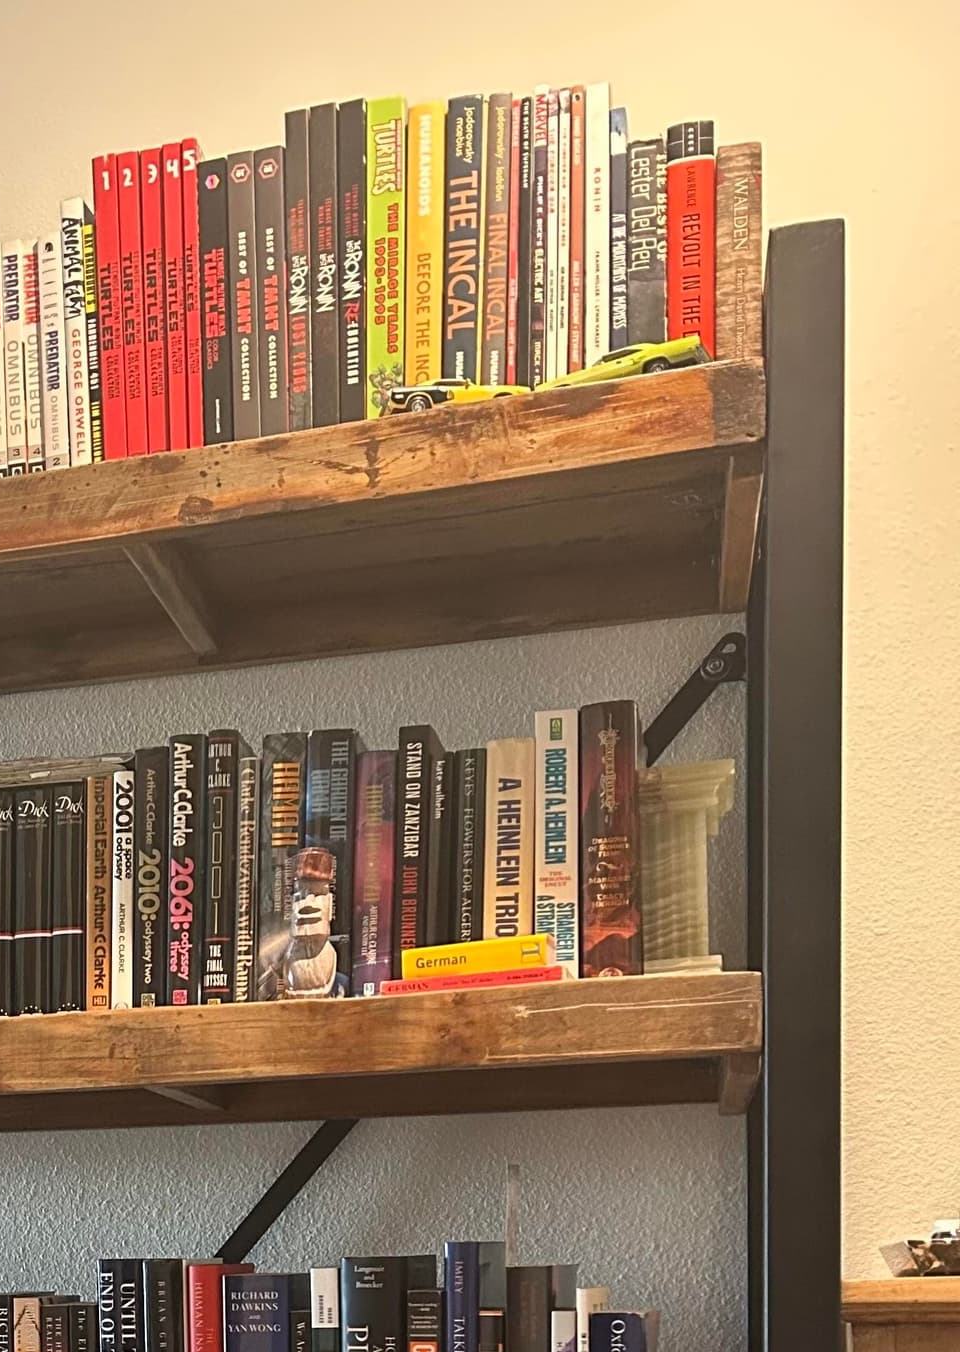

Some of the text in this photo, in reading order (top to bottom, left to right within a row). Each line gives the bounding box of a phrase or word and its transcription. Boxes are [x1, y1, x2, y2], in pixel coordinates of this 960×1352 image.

[102, 172, 110, 190] 1
[123, 168, 133, 186] 2
[147, 164, 157, 183] 3
[166, 159, 179, 179] 4
[183, 150, 195, 171] 5
[732, 178, 748, 251] WALDEN
[388, 203, 398, 354] THE MIRAGE YEARS
[447, 170, 478, 339] THE INCAL
[486, 213, 506, 341] FINAL INCAL
[3, 254, 19, 322] PREDATOR
[100, 263, 114, 351] TURTLES
[121, 252, 135, 345] TURTLES
[416, 252, 431, 347] BEFORE THE
[72, 328, 86, 457] GEORGE ORWELL
[544, 748, 567, 795] ROBERT
[403, 742, 422, 858] STAND ON ZANZIBAR
[94, 836, 108, 879] Earth
[494, 778, 522, 938] A HEINLEIN TRIO
[544, 811, 566, 865] HEINLEIN
[94, 885, 107, 931] Arthur
[94, 945, 108, 989] Clarke
[206, 958, 224, 972] FINAL
[416, 954, 467, 969] German
[100, 1272, 113, 1311] END
[120, 1282, 136, 1346] UNTIL
[100, 1315, 114, 1339] OF
